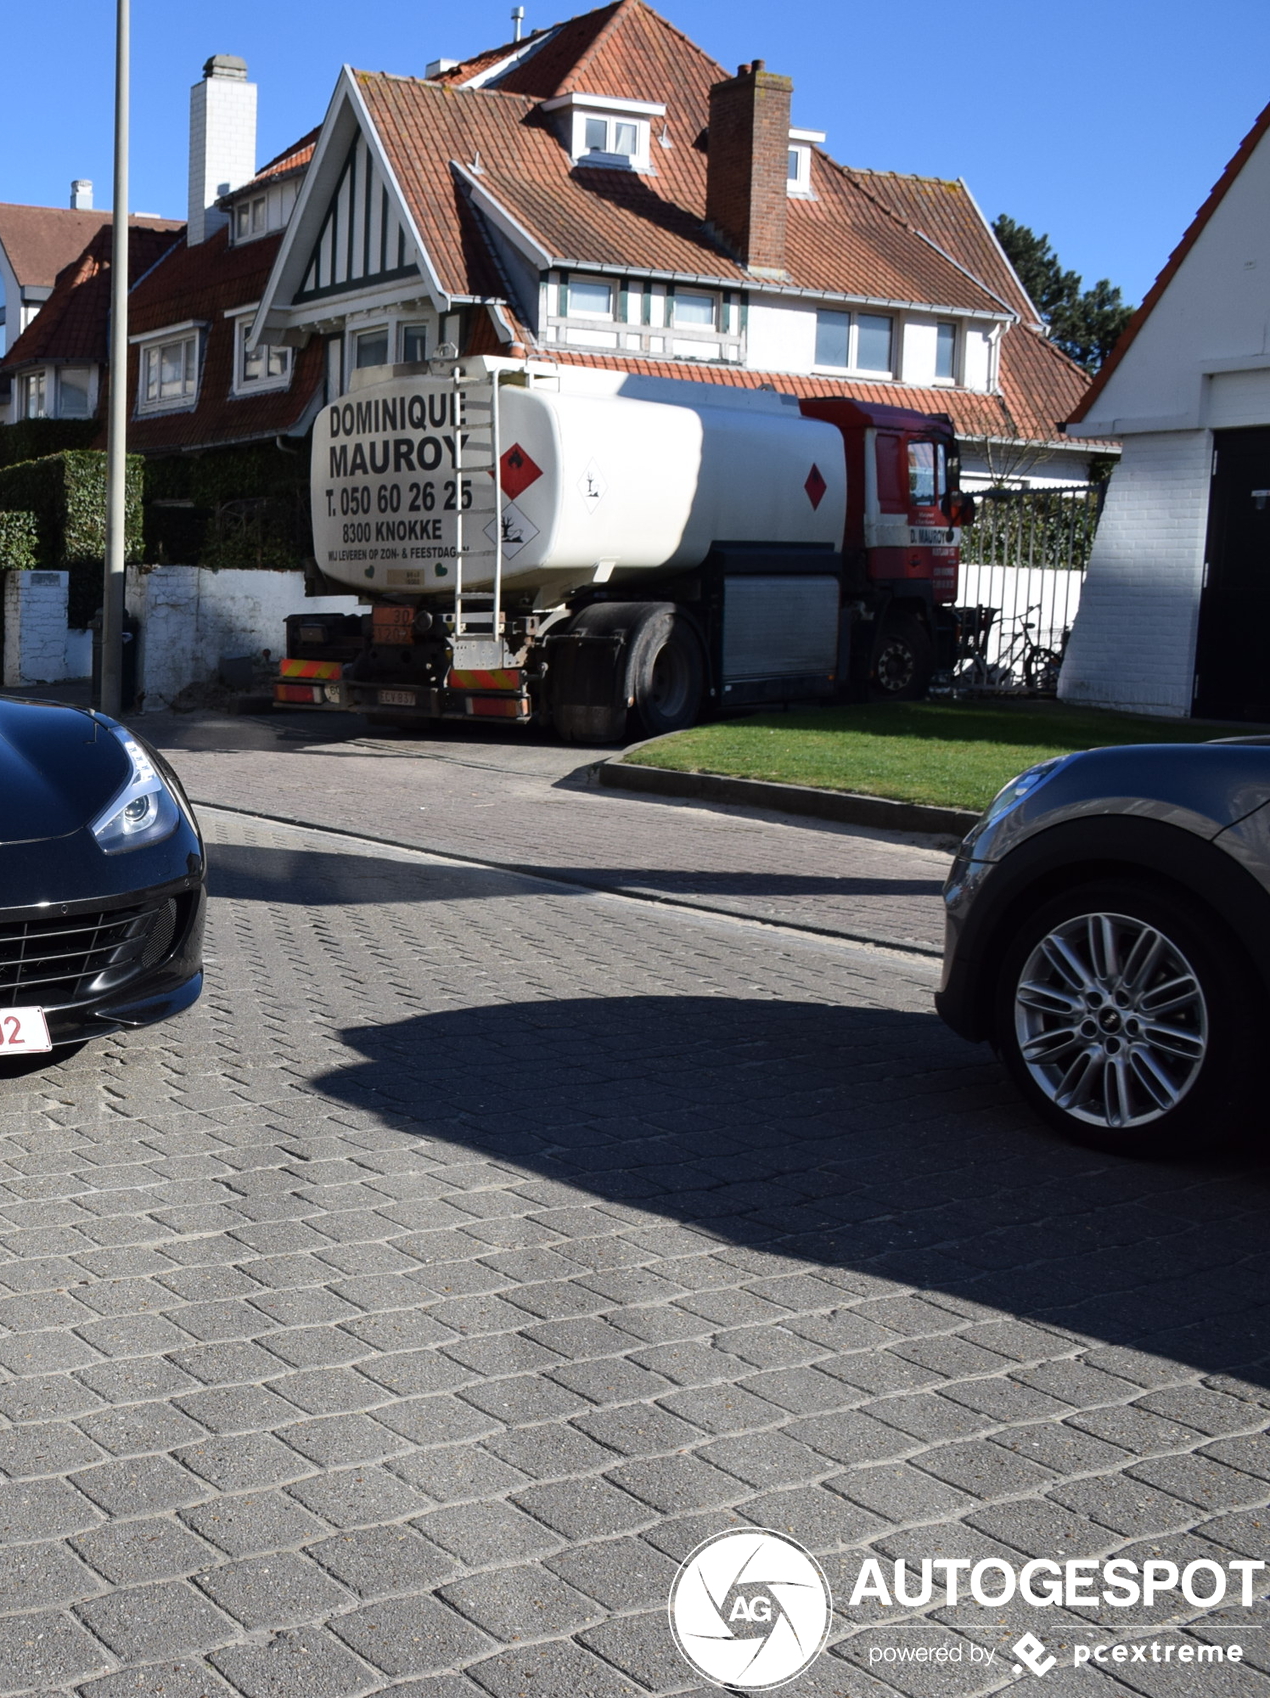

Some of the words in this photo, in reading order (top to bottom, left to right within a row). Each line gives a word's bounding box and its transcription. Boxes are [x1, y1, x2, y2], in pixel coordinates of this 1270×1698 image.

[330, 392, 466, 438] DOMINIQUE
[330, 434, 470, 478] MAUROY
[326, 489, 336, 517] T.
[341, 485, 371, 516] 050
[377, 483, 401, 513] 60
[408, 481, 435, 512] 26
[443, 480, 473, 511] 25
[342, 522, 371, 544] 8300
[375, 519, 442, 542] KNOKKE
[339, 549, 367, 562] LEVEREN
[368, 549, 379, 560] OP
[380, 548, 399, 560] ZON-
[401, 548, 408, 559] &
[410, 546, 470, 559] FEESTDAG
[394, 609, 410, 623] 30
[377, 628, 408, 642] 1202
